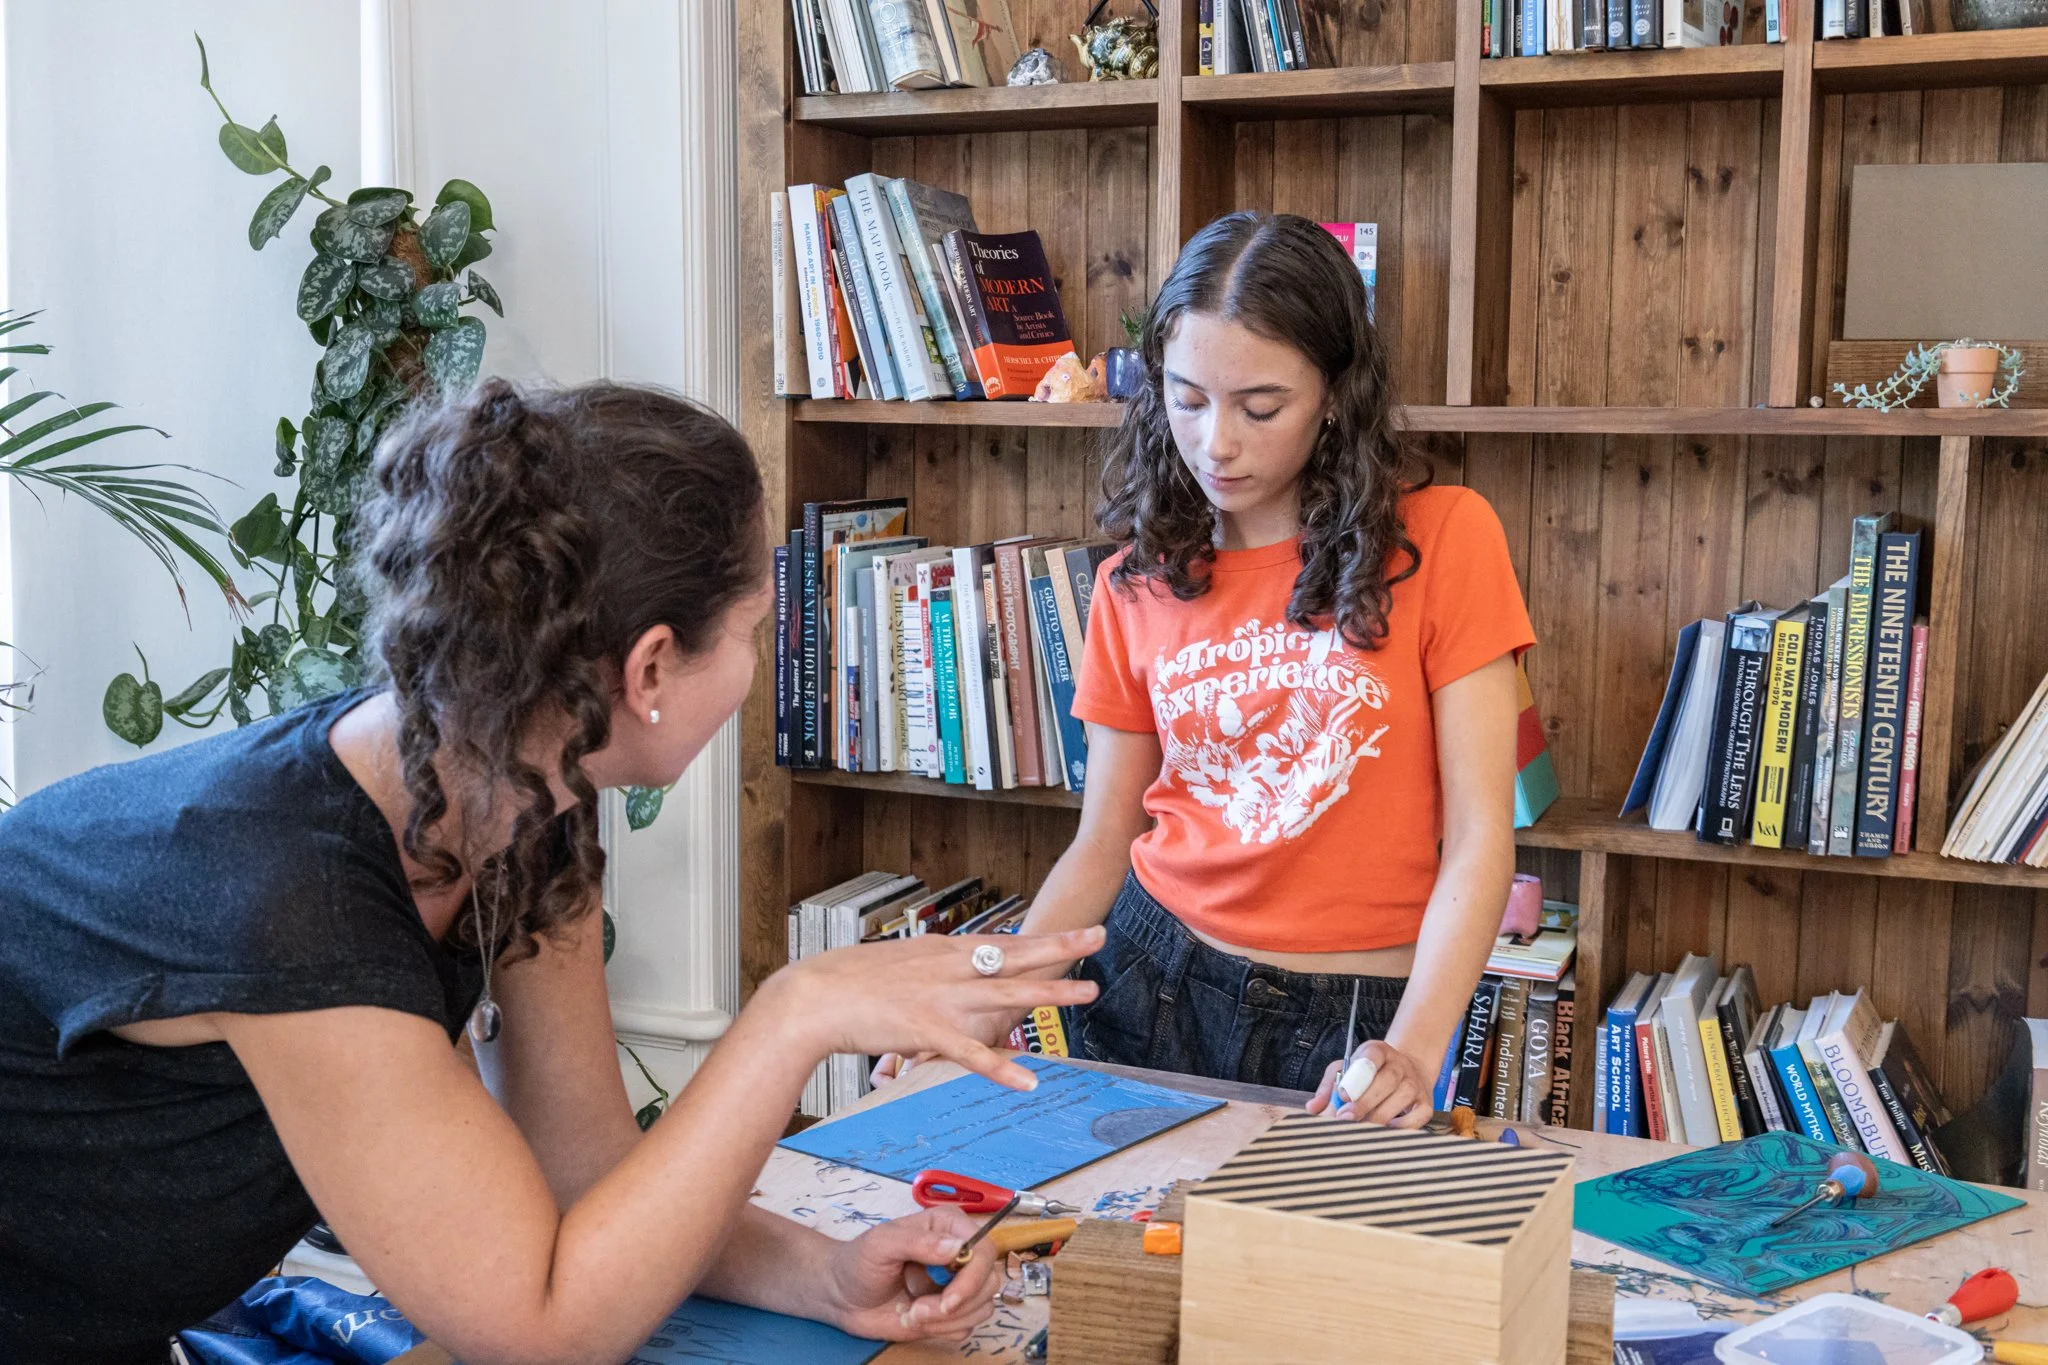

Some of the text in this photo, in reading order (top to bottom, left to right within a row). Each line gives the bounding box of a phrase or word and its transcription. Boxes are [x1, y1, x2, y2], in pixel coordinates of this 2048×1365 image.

[838, 209, 852, 237] how
[803, 222, 813, 255] MAKING
[847, 240, 857, 255] to
[968, 241, 1019, 260] Theories
[807, 257, 815, 273] ART
[809, 275, 816, 284] IN
[839, 250, 850, 279] MEXICAN
[858, 186, 912, 368] THE MAP BOOK PETER BARBER
[975, 260, 985, 275] of
[810, 286, 820, 316] AFRICA
[851, 259, 874, 325] decorate
[962, 275, 973, 303] MODERN
[980, 277, 1045, 295] MODERN
[987, 296, 1010, 312] ART
[1013, 311, 1055, 321] Source Book
[1020, 330, 1055, 340] and Critics
[1003, 356, 1033, 365] HERSCHEL
[1000, 552, 1011, 593] FASHION
[1853, 556, 1872, 587] THE
[983, 570, 1000, 679] THE PHOTOGRAPHY COURSE
[1005, 597, 1020, 670] PHOTOGRAPHY
[1044, 588, 1070, 682] GIOTTO DÜRER
[1828, 607, 1837, 638] LONDON
[1776, 632, 1786, 660] DESIGN
[1808, 617, 1825, 705] THOMAS JONES
[1833, 633, 1841, 661] SICKERT
[1842, 594, 1868, 719] IMPRESSIONISTS
[792, 658, 799, 667] of
[894, 591, 909, 750] THE STORY OF ART Gombrich
[942, 612, 957, 719] AUTHENTIC DECOR
[1802, 651, 1812, 700] REDISCOVERED
[1825, 654, 1833, 674] PARIS
[792, 669, 800, 692] posters
[1776, 634, 1799, 753] COLD WAR MODERN
[1866, 541, 1910, 822] THE NINETEENTH CENTURY
[1912, 676, 1920, 692] Book
[1720, 655, 1745, 807] NATIONAL GEOGRAPHIC GREATEST PHOTOGRAPHS
[1727, 657, 1763, 809] THROUGH THE LENS
[1906, 701, 1920, 736] FABRIC
[1859, 842, 1889, 850] HUDSON
[1860, 831, 1889, 839] THAMES
[1462, 992, 1491, 1068] SAHARA
[1722, 1022, 1734, 1039] The
[1498, 1033, 1514, 1078] Indian
[1528, 1019, 1549, 1078] GOYA
[1640, 1036, 1650, 1059] Picture
[1727, 1040, 1740, 1064] World
[1551, 1001, 1574, 1127] Black Africa
[1597, 1039, 1608, 1108] handy andy's
[1611, 1024, 1622, 1112] ART SCHOOL
[1644, 1059, 1652, 1073] this:
[1733, 1064, 1744, 1075] of
[1648, 1084, 1656, 1102] artist
[1705, 1025, 1734, 1136] THE NEW CRAFT COLLECTION
[1786, 1064, 1825, 1141] WORLD MYTHO
[1878, 1080, 1907, 1131] Tom Phillips
